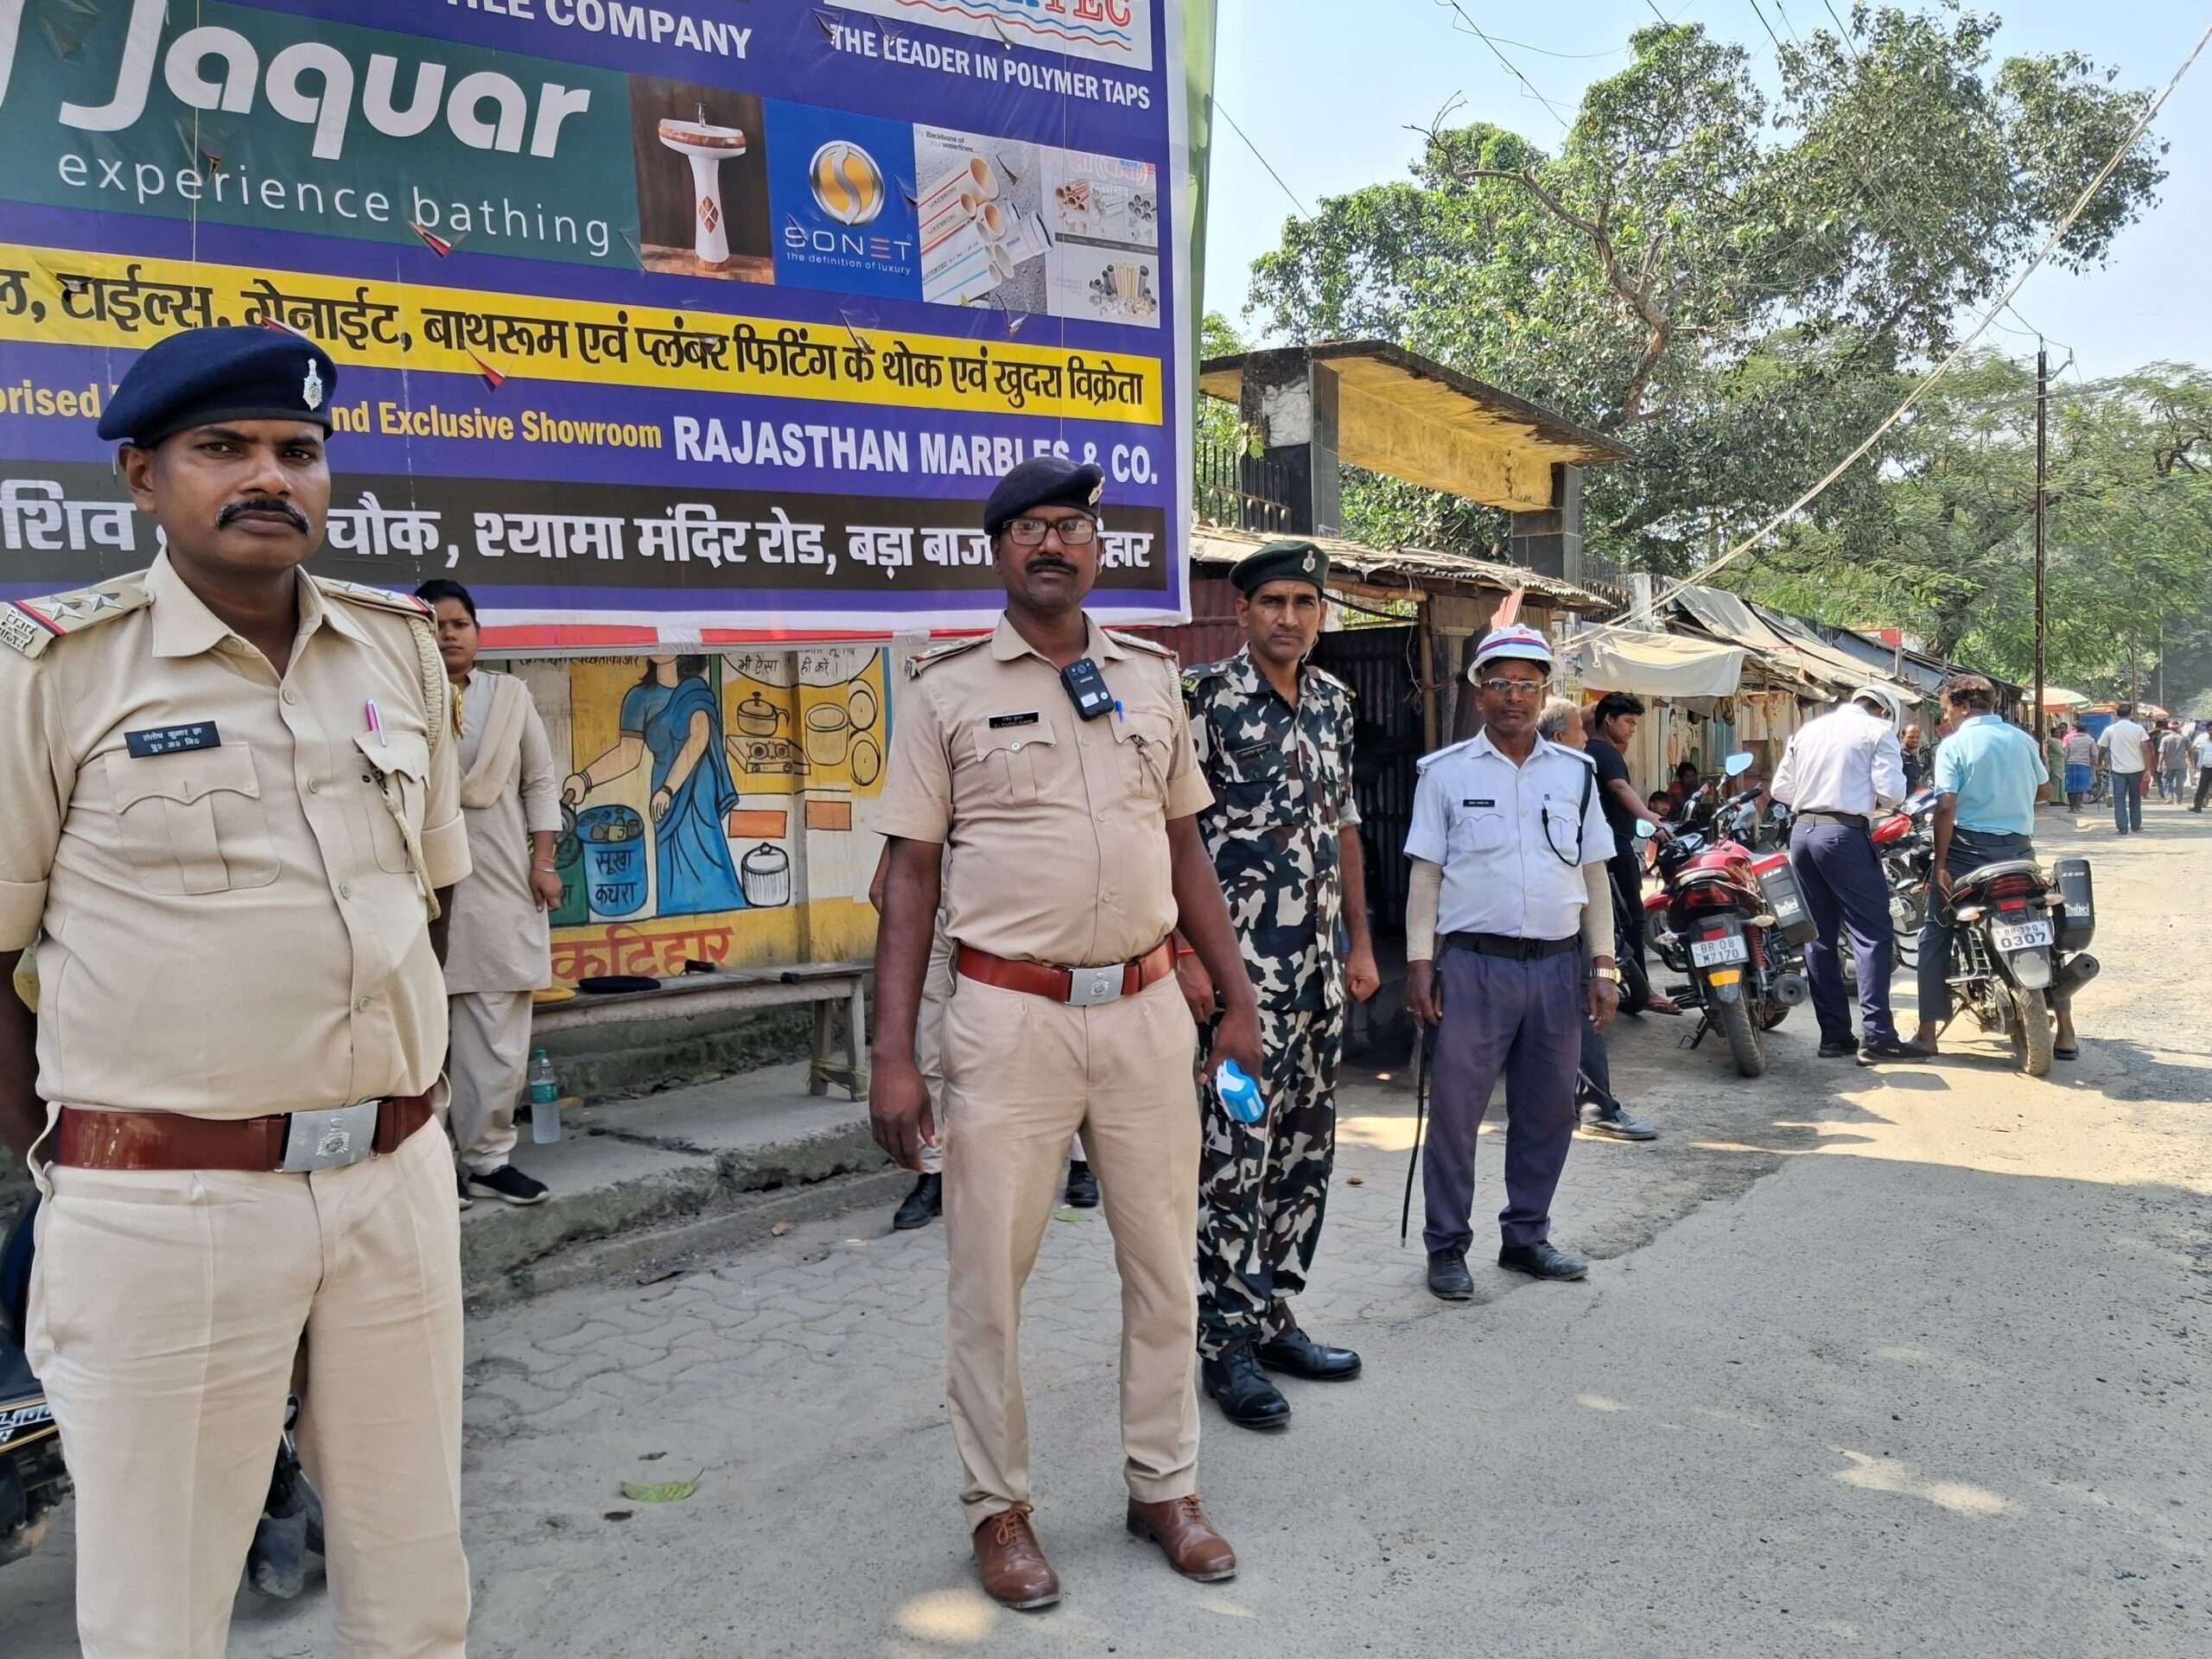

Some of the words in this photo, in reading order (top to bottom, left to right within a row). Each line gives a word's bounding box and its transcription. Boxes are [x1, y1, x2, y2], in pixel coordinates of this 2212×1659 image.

[545, 0, 752, 59] COMPANY
[830, 24, 877, 56] THE
[883, 36, 969, 76] LEADER
[976, 54, 998, 80] IN
[1004, 60, 1098, 99] POLYMER
[1103, 79, 1151, 109] TAPS
[59, 0, 591, 160] Jaquar
[58, 153, 390, 222] experience
[413, 185, 609, 257] bathing
[785, 226, 912, 261] SONET
[786, 251, 804, 261] the
[808, 255, 862, 269] definition
[878, 264, 912, 276] luxury
[421, 308, 569, 358] बाथरूम
[575, 311, 628, 364] एवं
[634, 315, 729, 372] प्लंबर
[733, 323, 837, 381] फिटिंग
[842, 337, 875, 383] के
[883, 340, 944, 389] थोक
[949, 346, 988, 394] एवं
[993, 359, 1062, 410] खुदरा
[1067, 356, 1143, 406] विक्रेता
[378, 402, 514, 441] Exclusive
[521, 410, 663, 449] Showroom
[673, 416, 909, 474] RAJASTHAN
[1111, 443, 1158, 485] CO.
[474, 512, 625, 560] श्यामा
[633, 503, 751, 569] मंदिर
[755, 506, 837, 575] रोड,
[845, 525, 913, 580] बड़ा
[551, 923, 735, 982] कटिहार
[2000, 931, 2046, 949] 0307
